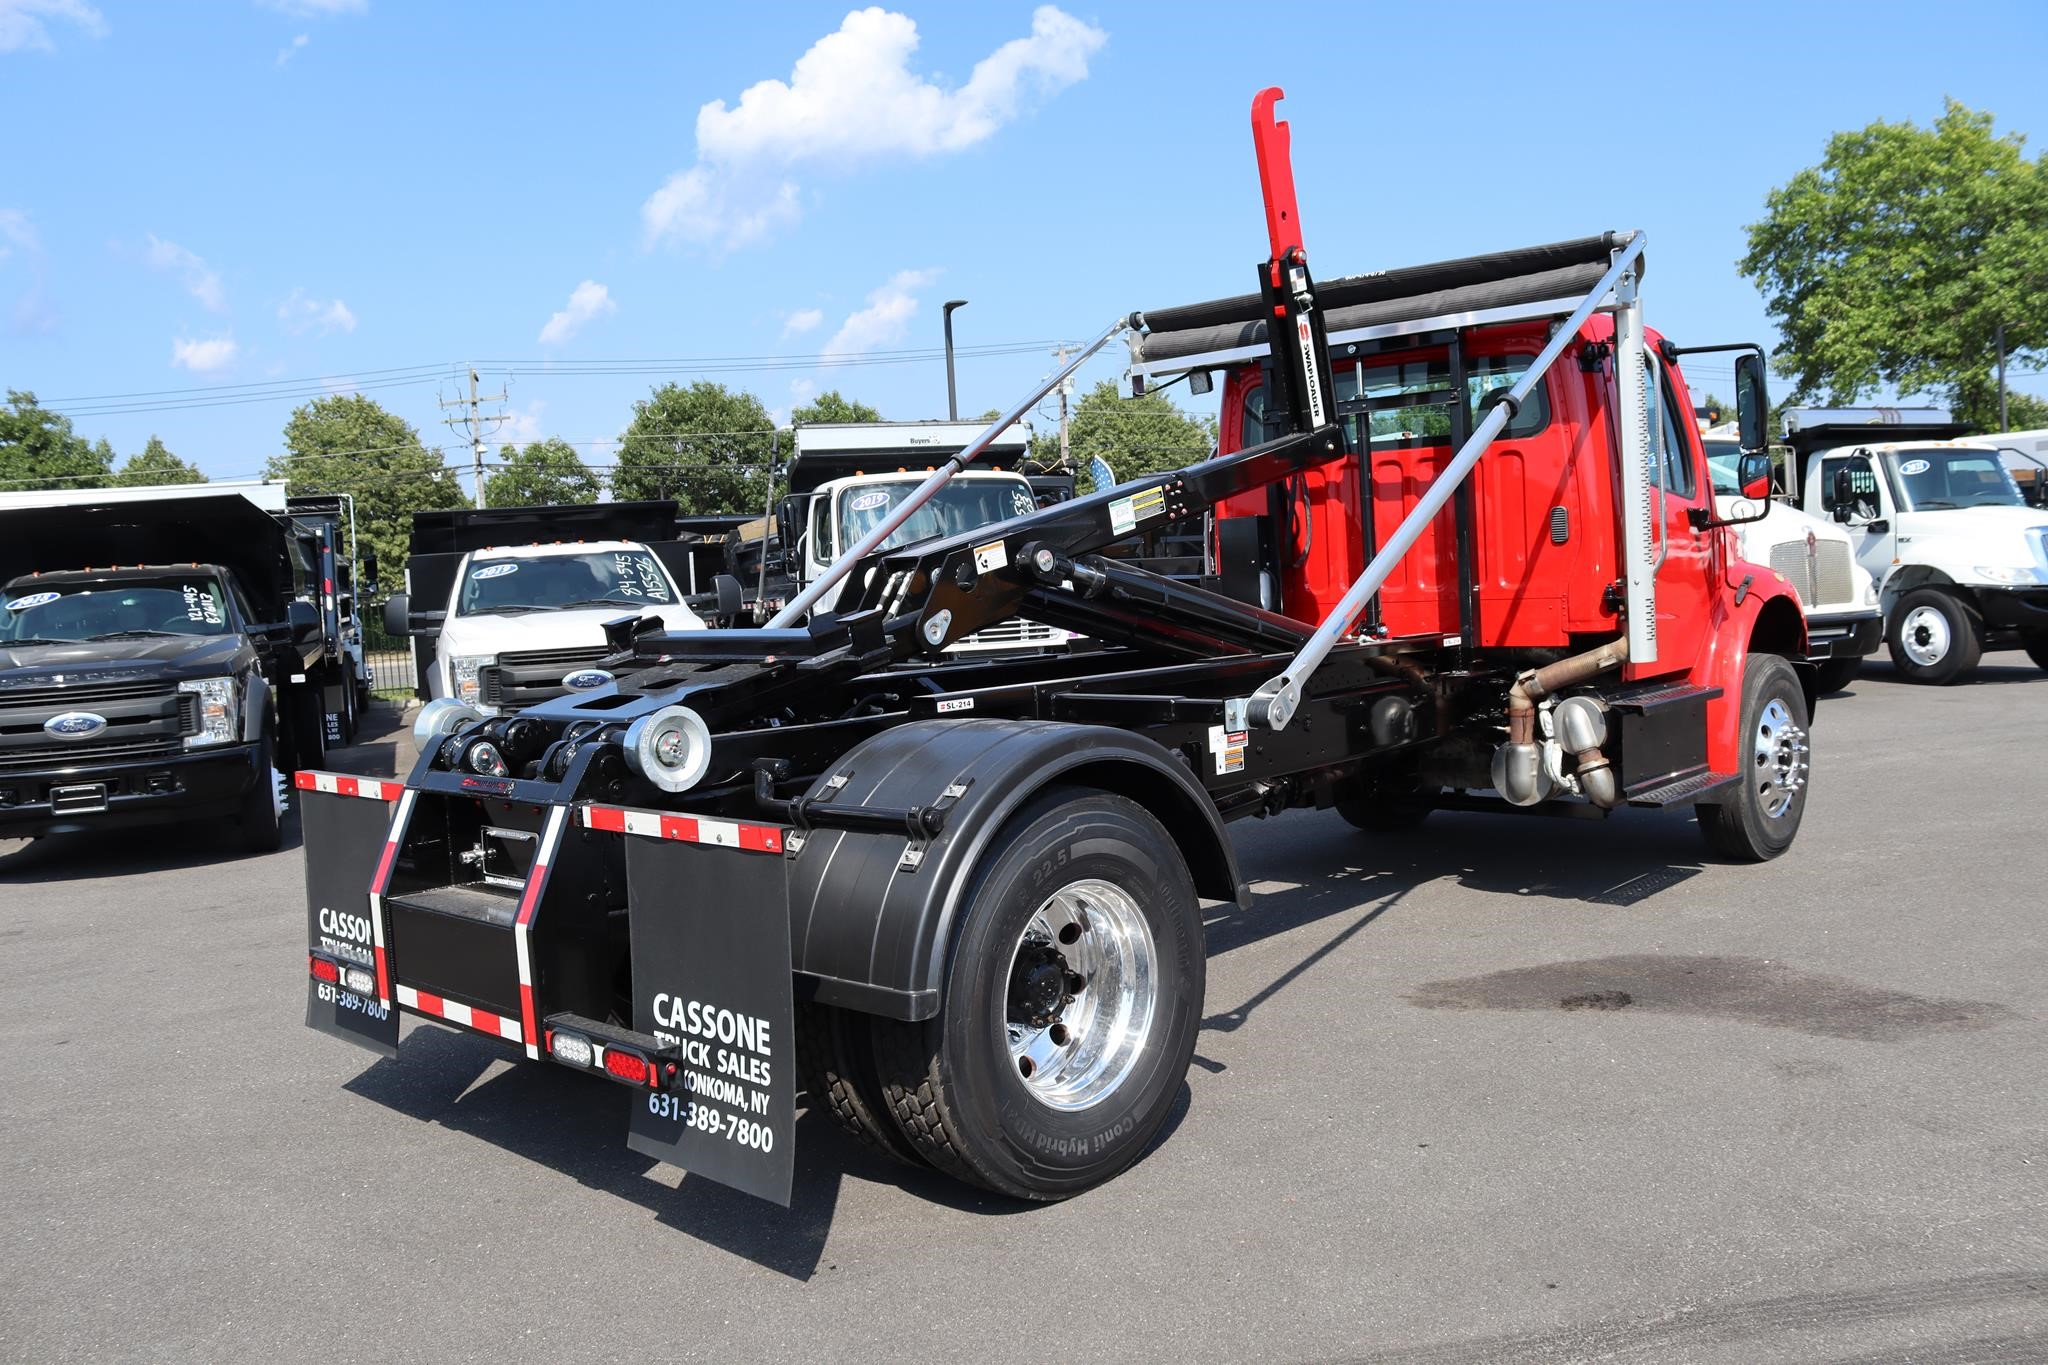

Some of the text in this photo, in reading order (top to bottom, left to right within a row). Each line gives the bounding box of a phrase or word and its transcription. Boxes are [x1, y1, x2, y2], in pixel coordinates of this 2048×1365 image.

[1303, 343, 1320, 417] SWAPLOADER
[910, 438, 930, 446] Buyers
[859, 494, 884, 508] 2019
[577, 675, 602, 688] Ford
[946, 700, 971, 710] SL-214
[60, 718, 91, 732] Ford
[1033, 849, 1067, 887] 22.5
[319, 908, 372, 945] CASSON
[652, 993, 771, 1056] CASSONE
[717, 1049, 771, 1086] SALES
[684, 1069, 770, 1116] ONKOMA, NY
[649, 1093, 773, 1153] 631-389-7800
[1094, 1116, 1134, 1149] Conti
[1035, 1131, 1089, 1156] Hybrid
